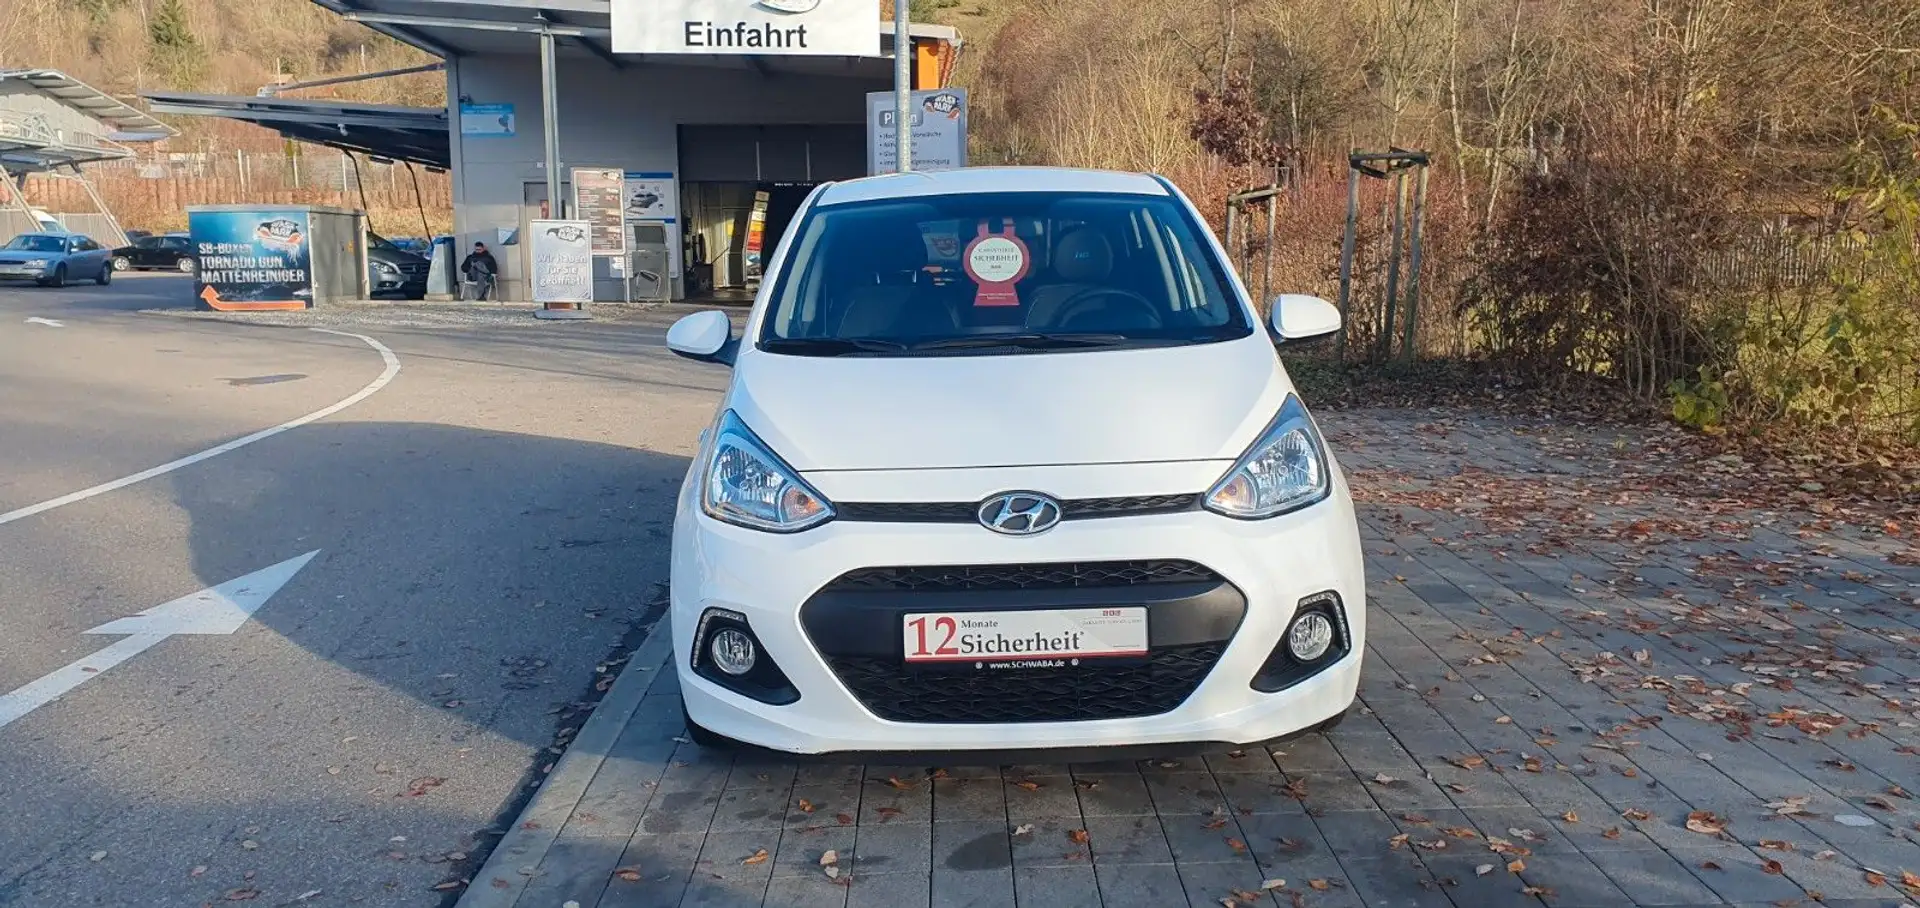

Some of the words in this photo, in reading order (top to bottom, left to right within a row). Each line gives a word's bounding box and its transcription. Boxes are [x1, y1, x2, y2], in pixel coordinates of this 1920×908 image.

[685, 21, 808, 48] Einfahrt
[199, 243, 253, 254] SB-BOXEN
[199, 255, 256, 269] TORNADO
[537, 253, 554, 263] Wir
[556, 252, 587, 263] haben
[563, 265, 579, 275] Sie
[201, 269, 305, 283] MATTENREINIGER
[961, 620, 999, 629] Monate
[908, 616, 959, 656] 12
[989, 659, 1066, 669] www.SCHWABA.de
